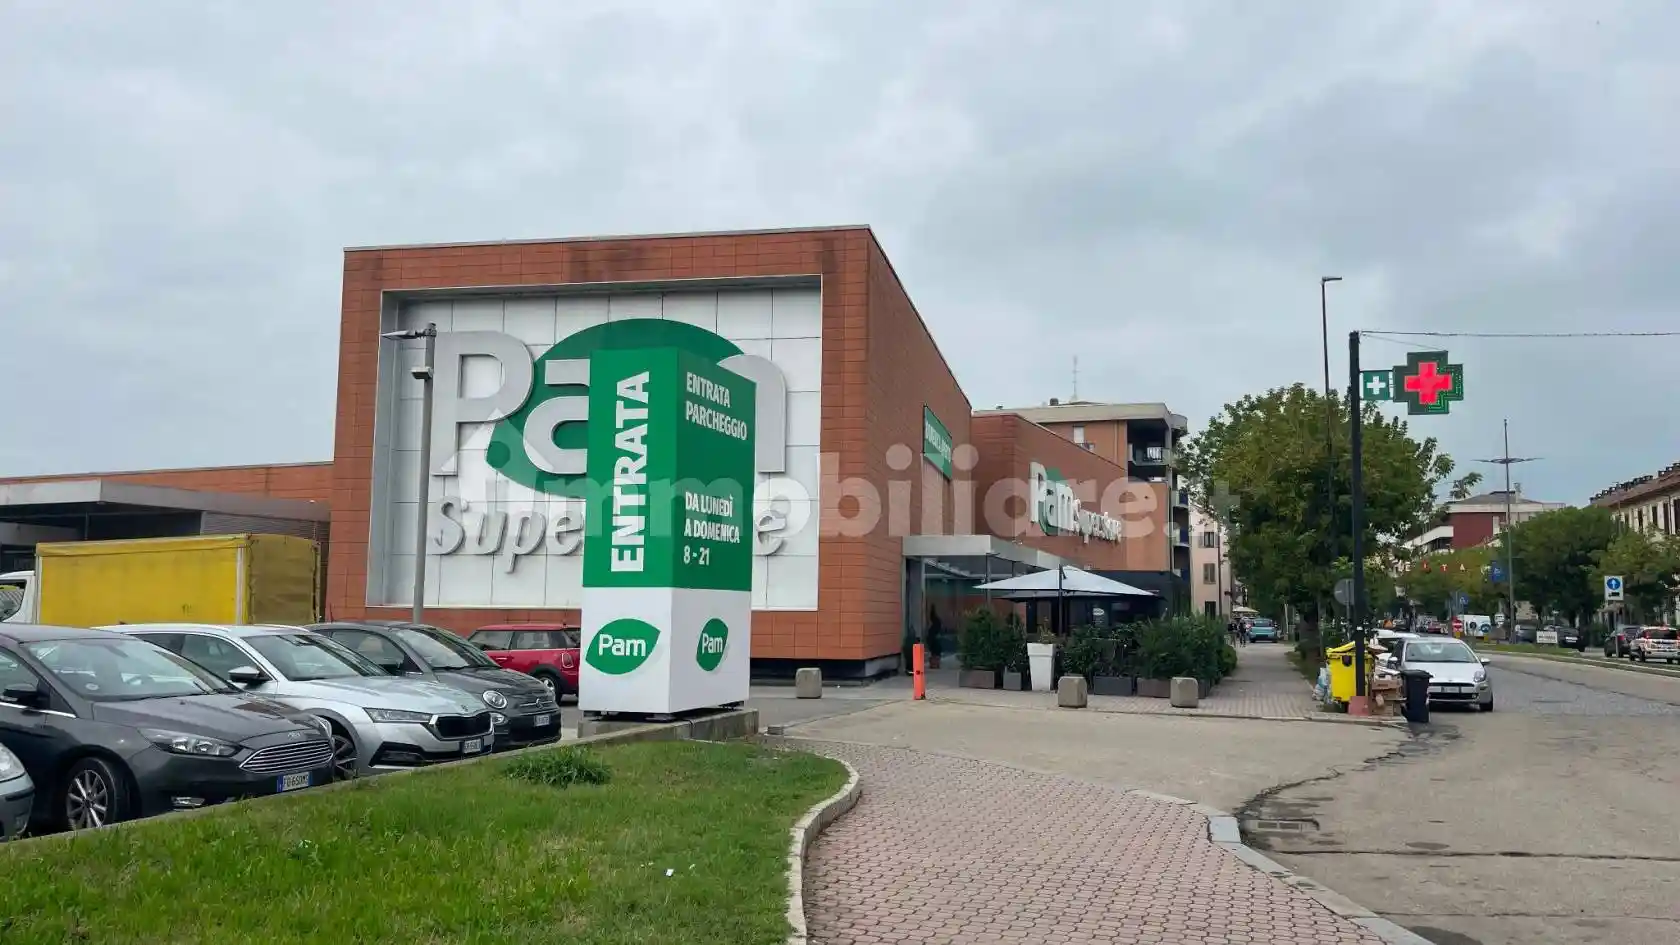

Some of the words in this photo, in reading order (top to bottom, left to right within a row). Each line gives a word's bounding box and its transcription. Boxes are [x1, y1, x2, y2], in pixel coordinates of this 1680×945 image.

[686, 371, 731, 408] ENTRATA
[685, 400, 748, 441] PARCHEGGIO
[611, 371, 650, 572] ENTRATA
[685, 491, 700, 512] DA
[684, 518, 692, 537] A
[693, 519, 740, 543] DOMENICA
[683, 544, 691, 565] 8
[698, 546, 710, 566] 21
[598, 633, 647, 657] Pam
[701, 632, 723, 655] Pam
